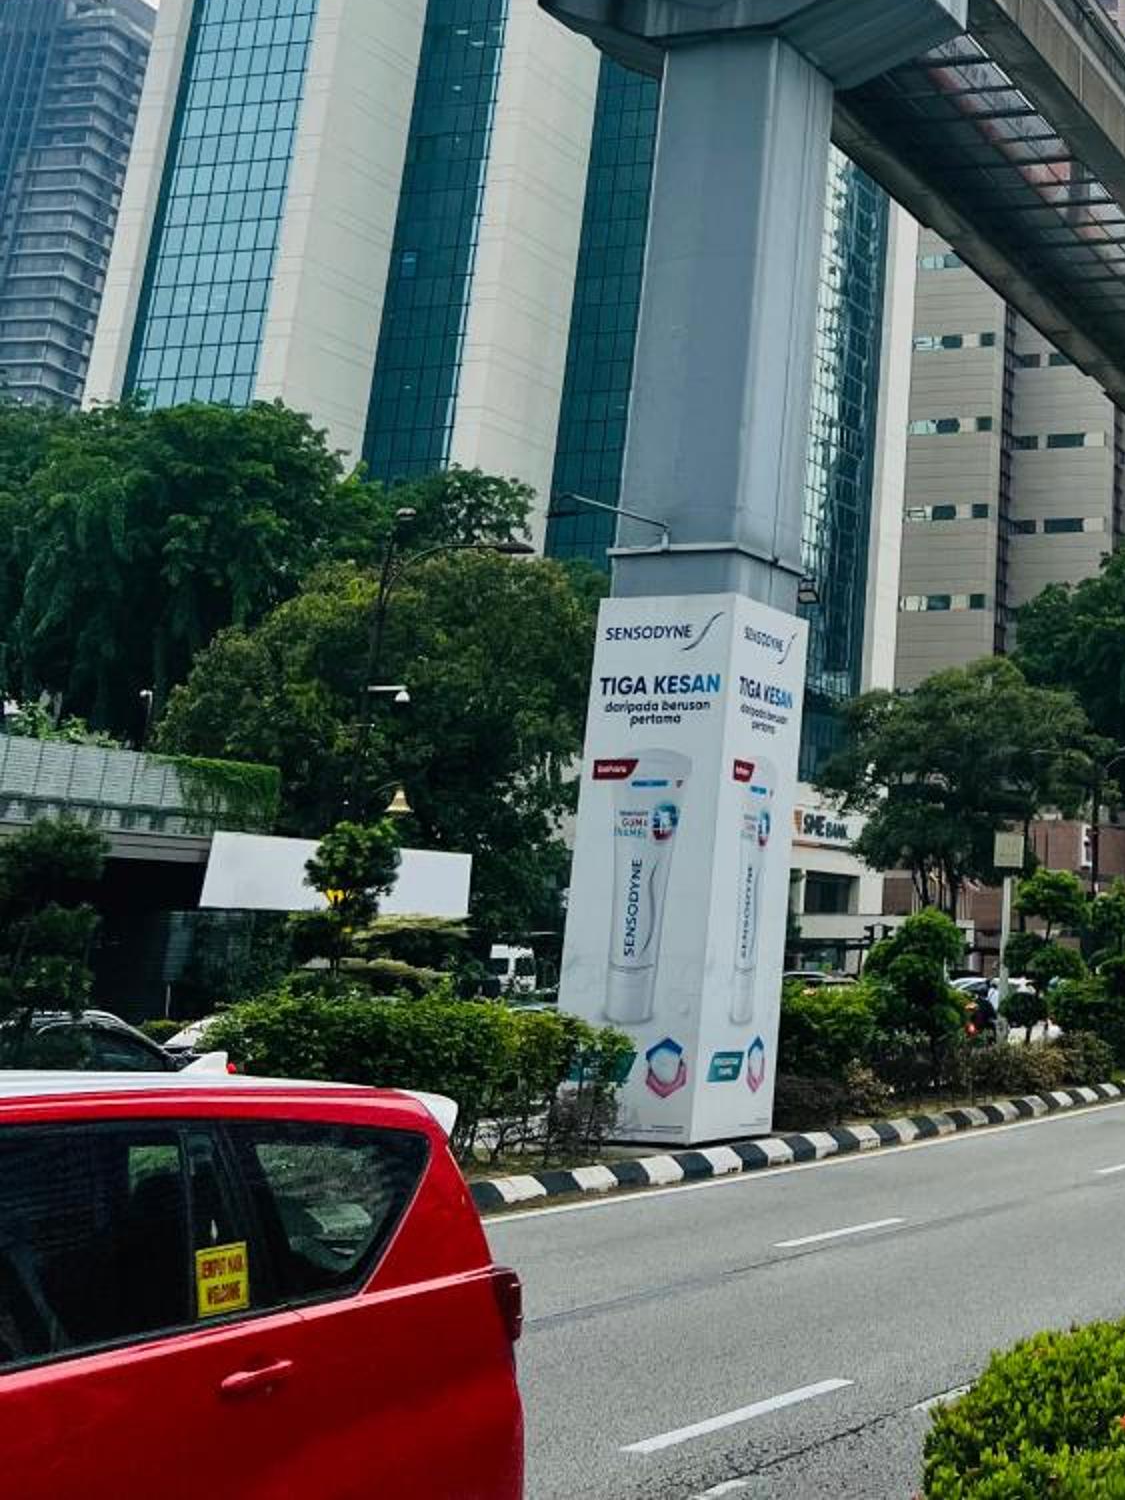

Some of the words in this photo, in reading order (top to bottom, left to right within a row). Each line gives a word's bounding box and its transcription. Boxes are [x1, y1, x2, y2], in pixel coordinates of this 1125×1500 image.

[605, 624, 693, 641] SENSODYNE
[600, 676, 647, 696] TIGA
[653, 674, 721, 694] KESAN
[739, 676, 761, 700] TIGA
[764, 683, 793, 709] KESAN
[604, 700, 659, 714] daripada
[661, 699, 710, 711] berusan
[630, 713, 681, 728] pertama
[803, 814, 826, 837] SME
[826, 821, 848, 839] BANK
[623, 858, 643, 957] SENSODYNE
